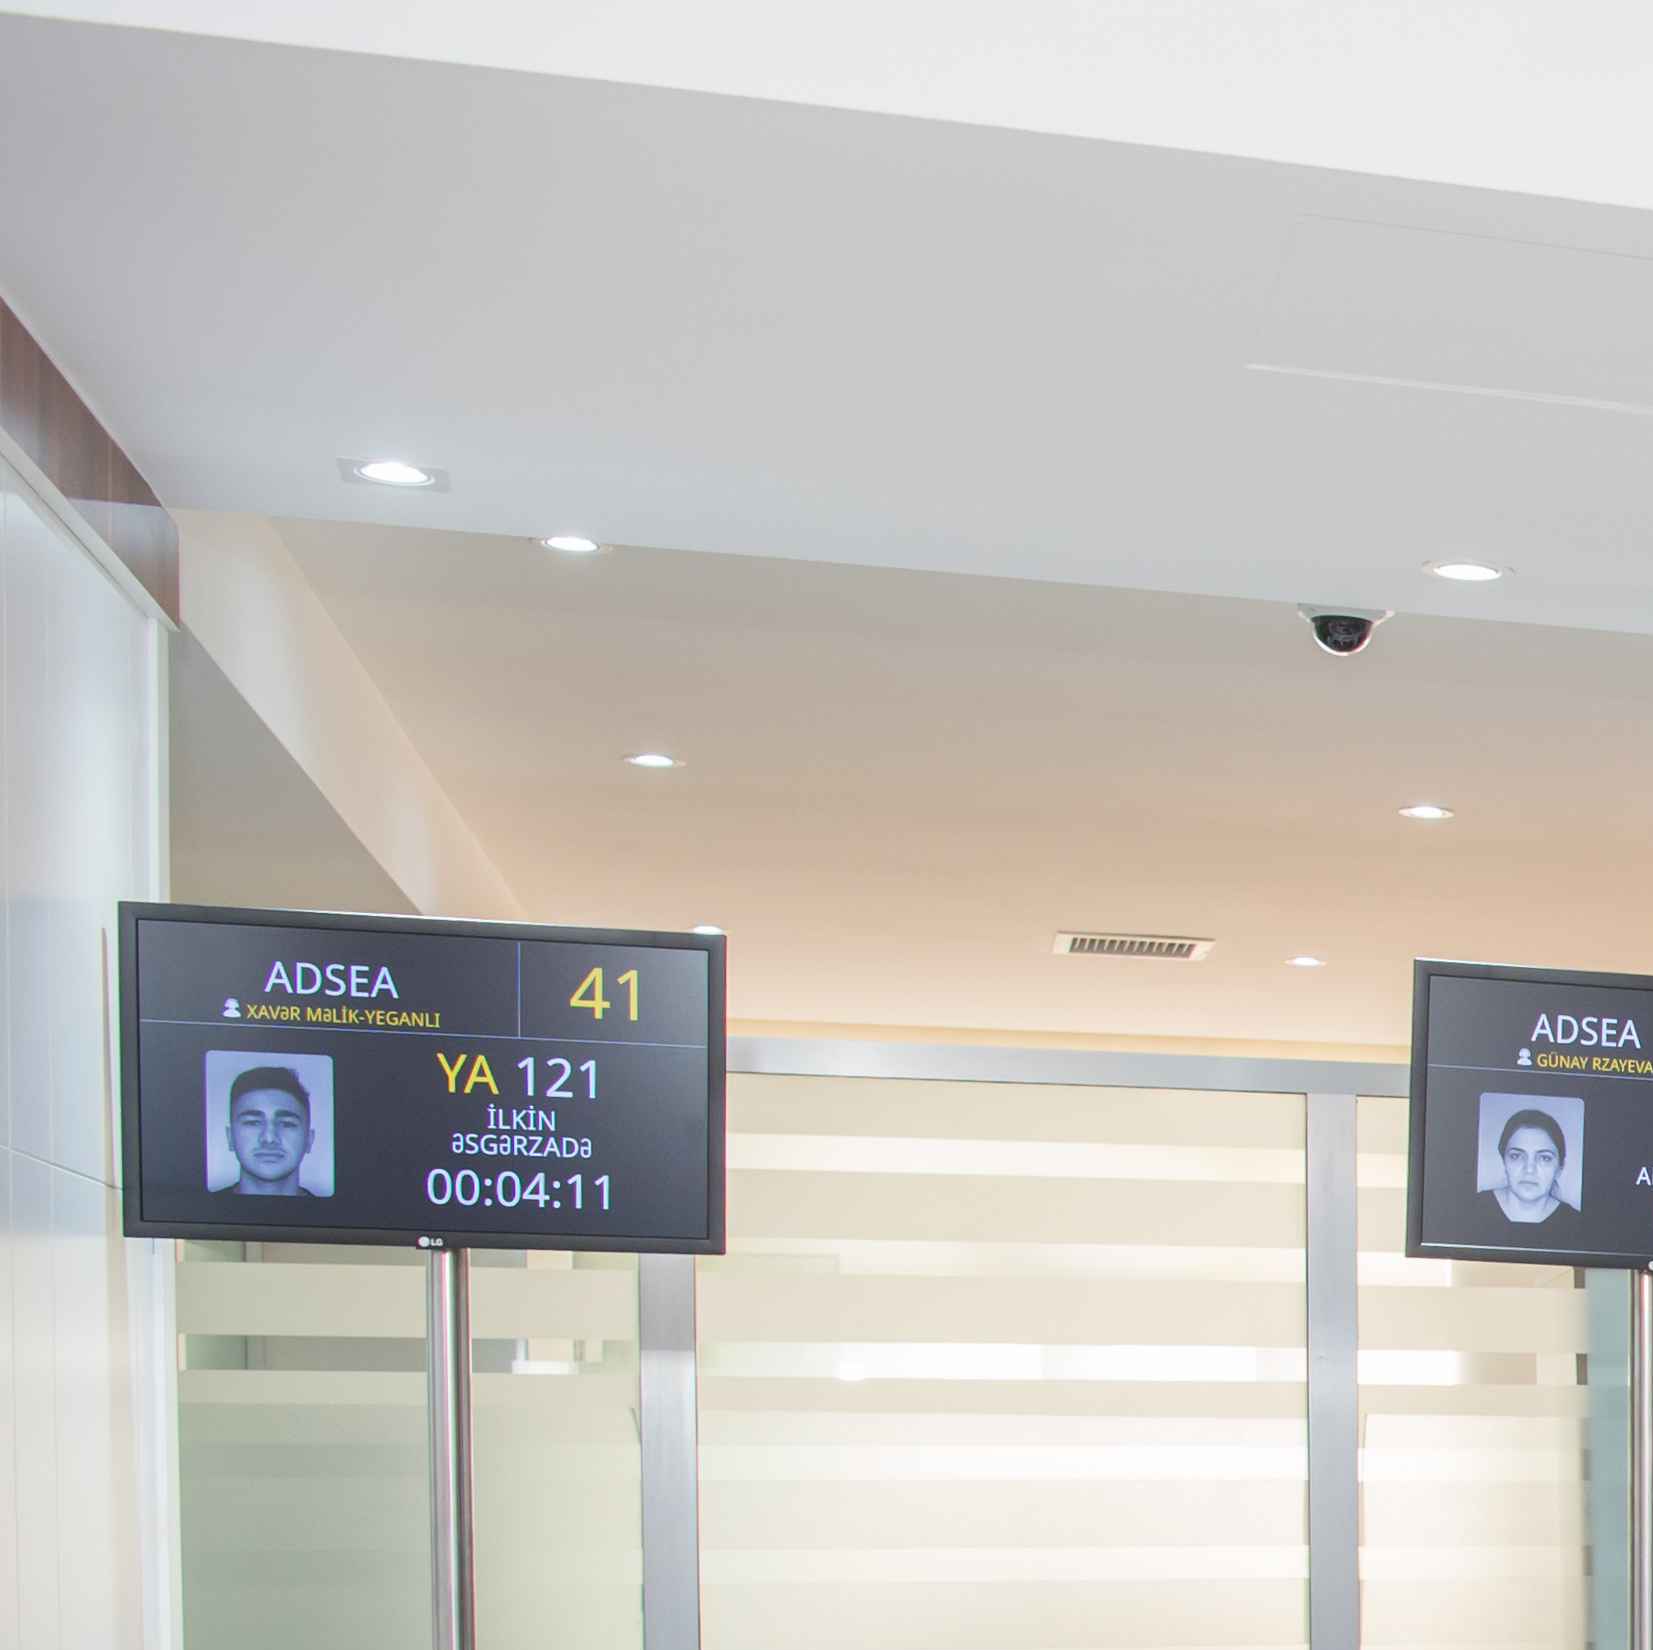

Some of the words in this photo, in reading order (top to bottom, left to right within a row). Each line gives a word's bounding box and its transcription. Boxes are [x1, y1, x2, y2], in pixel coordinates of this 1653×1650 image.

[263, 960, 399, 999] ADSEA
[569, 967, 639, 1021] 41
[246, 1004, 301, 1021] XAVƏR
[1530, 1013, 1641, 1049] ADSEA
[436, 1052, 500, 1095] YA
[517, 1056, 597, 1099] 121
[1536, 1051, 1589, 1070] GÜNAY
[1592, 1057, 1653, 1075] RZAYEVA
[487, 1103, 556, 1132] İLKİN
[426, 1168, 610, 1210] 00:04:11
[430, 1237, 444, 1247] LG
